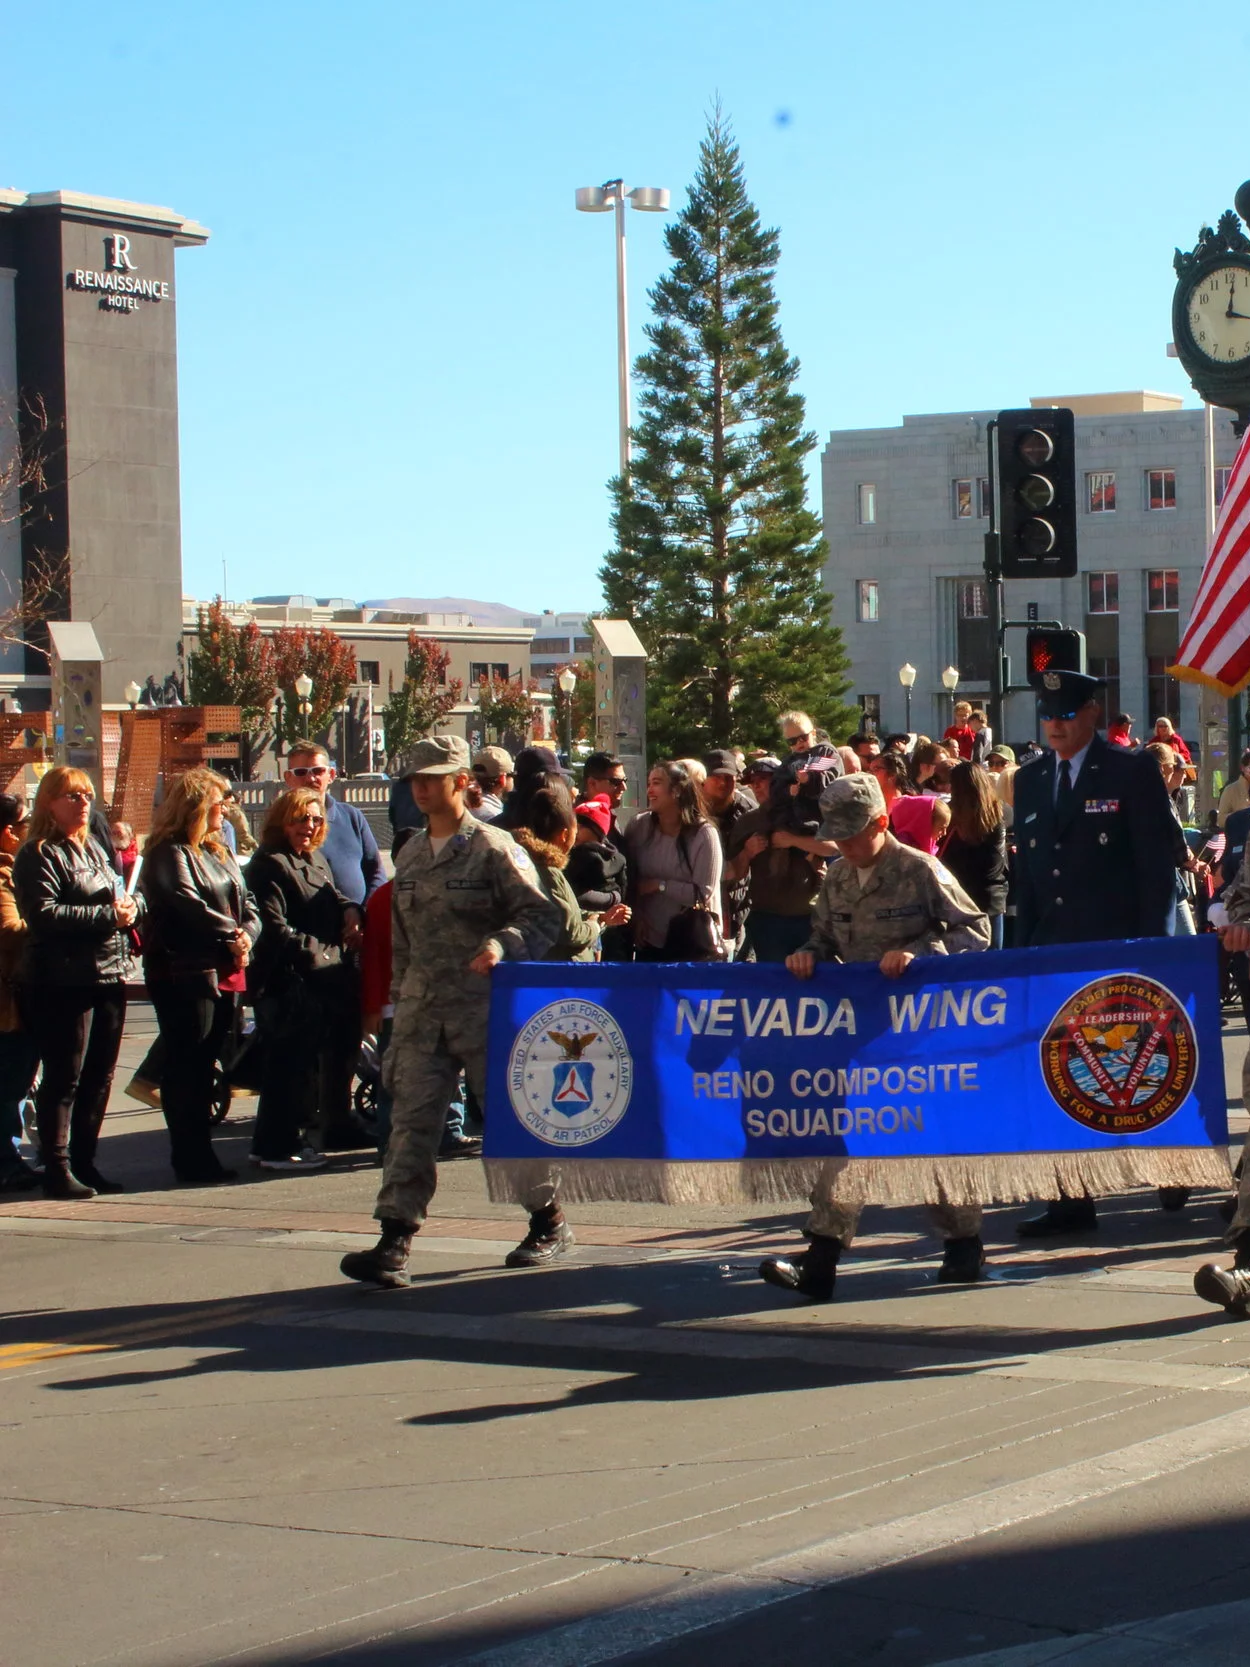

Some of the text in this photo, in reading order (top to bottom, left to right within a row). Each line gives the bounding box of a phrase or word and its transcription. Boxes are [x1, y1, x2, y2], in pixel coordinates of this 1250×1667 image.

[112, 233, 138, 270] R
[75, 268, 169, 298] RENAISSANCE
[1210, 279, 1219, 291] 11
[1224, 273, 1235, 284] 12
[1243, 278, 1249, 287] 1
[108, 294, 140, 310] HOTEL
[1199, 294, 1209, 305] 10
[1193, 312, 1200, 323] 9
[1199, 330, 1206, 341] 8
[1212, 343, 1219, 354] 7
[1228, 347, 1235, 358] 6
[675, 985, 1007, 1037] NEVADA WING
[1073, 984, 1166, 1014] CADET PROGRAMS
[1085, 1011, 1152, 1024] LEADERSHIP
[511, 1003, 629, 1091] UNITED STATES AIR FORCE AUXILIARY
[1126, 1031, 1163, 1090] VOLUNTEER
[1072, 1031, 1117, 1094] COMMUNITY
[692, 1062, 981, 1099] RENO COMPOSITE
[1050, 1031, 1190, 1127] WORKING FOR A DRUG FREE UNIVERSE
[525, 1111, 614, 1141] CIVIL AIR PATROL
[745, 1106, 925, 1138] SQUADRON
